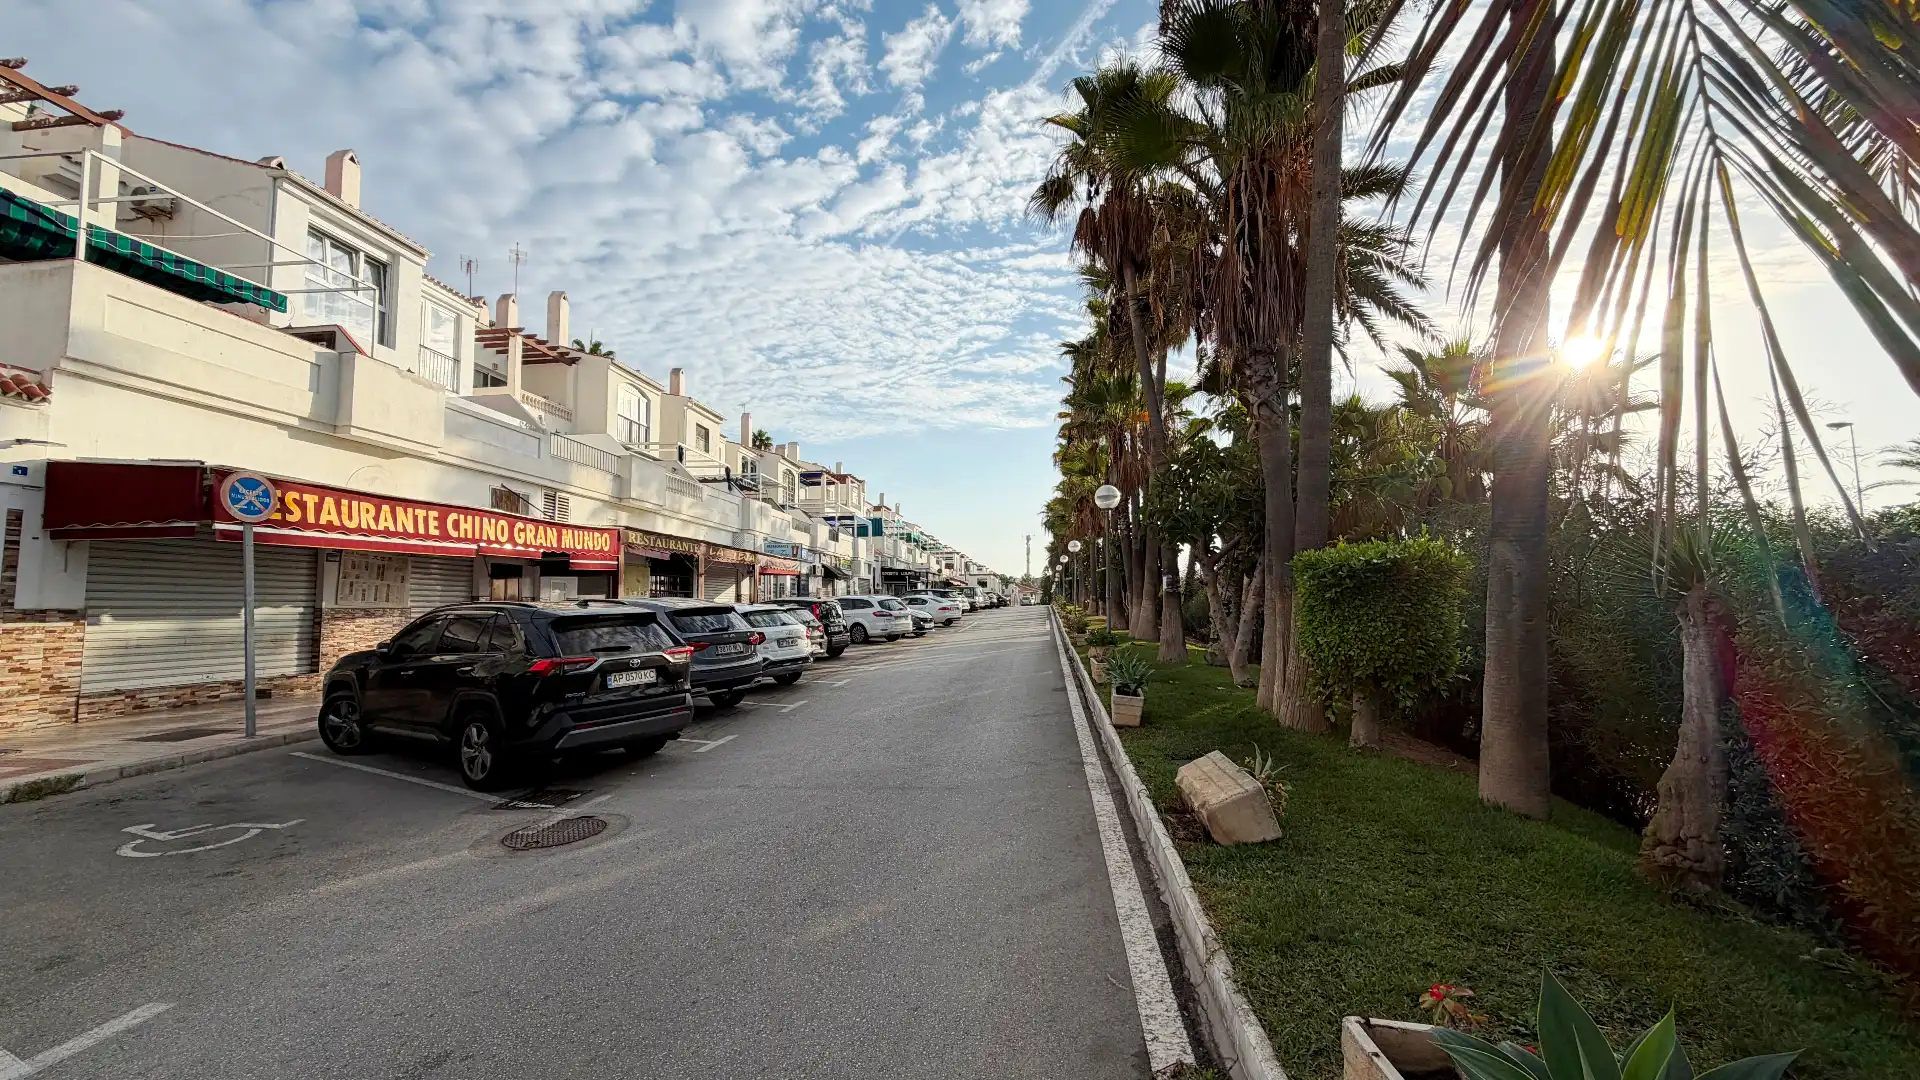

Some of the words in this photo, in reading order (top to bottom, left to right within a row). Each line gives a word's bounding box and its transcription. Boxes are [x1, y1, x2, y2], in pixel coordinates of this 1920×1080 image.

[267, 489, 440, 536] ESTAURANTE
[446, 512, 509, 543] CHINO
[513, 521, 558, 548] GRAN
[561, 528, 611, 552] MUNDO
[627, 531, 700, 554] RESTAURANTE
[708, 545, 724, 557] LA
[732, 551, 756, 563] TEJA
[612, 673, 624, 684] AP
[625, 671, 643, 682] 0570
[644, 669, 656, 680] KC
